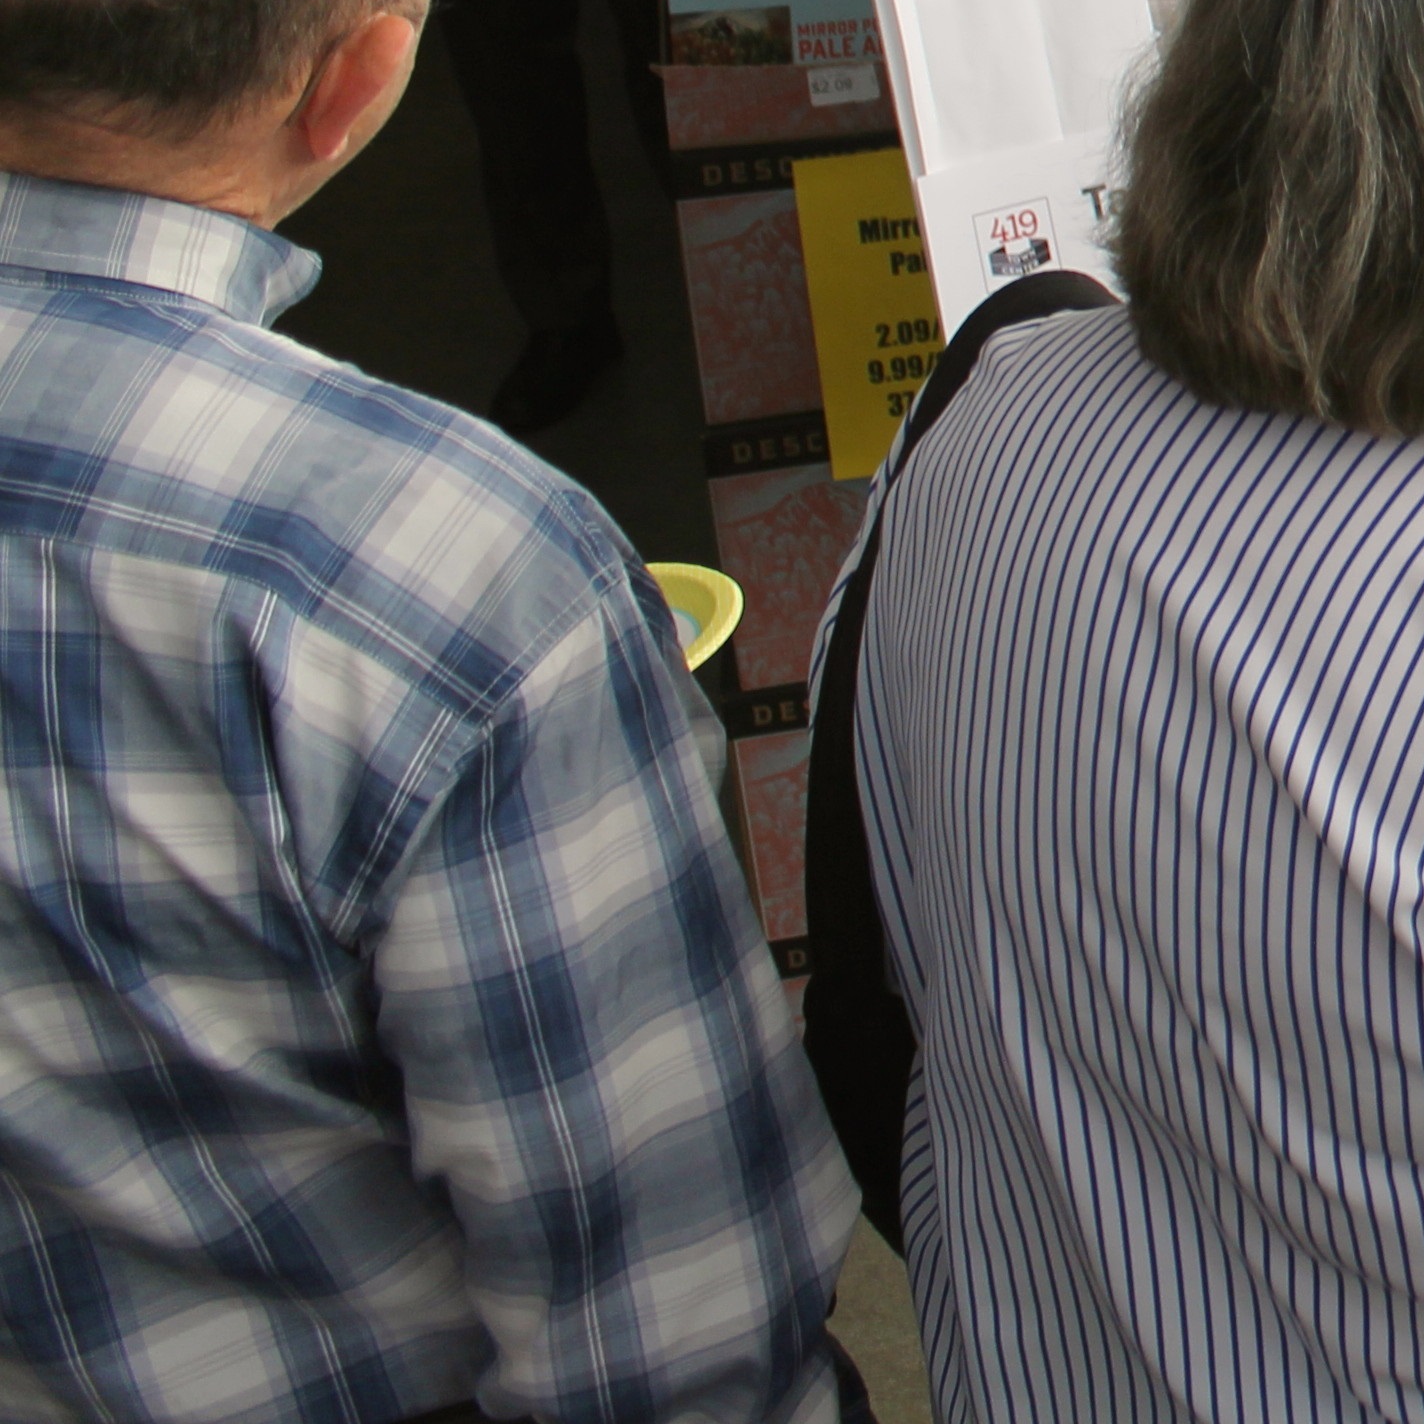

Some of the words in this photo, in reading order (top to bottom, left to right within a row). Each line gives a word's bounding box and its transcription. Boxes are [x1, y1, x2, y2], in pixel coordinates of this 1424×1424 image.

[798, 20, 858, 37] MIRROR
[799, 36, 856, 60] PALE
[990, 209, 1038, 243] 419
